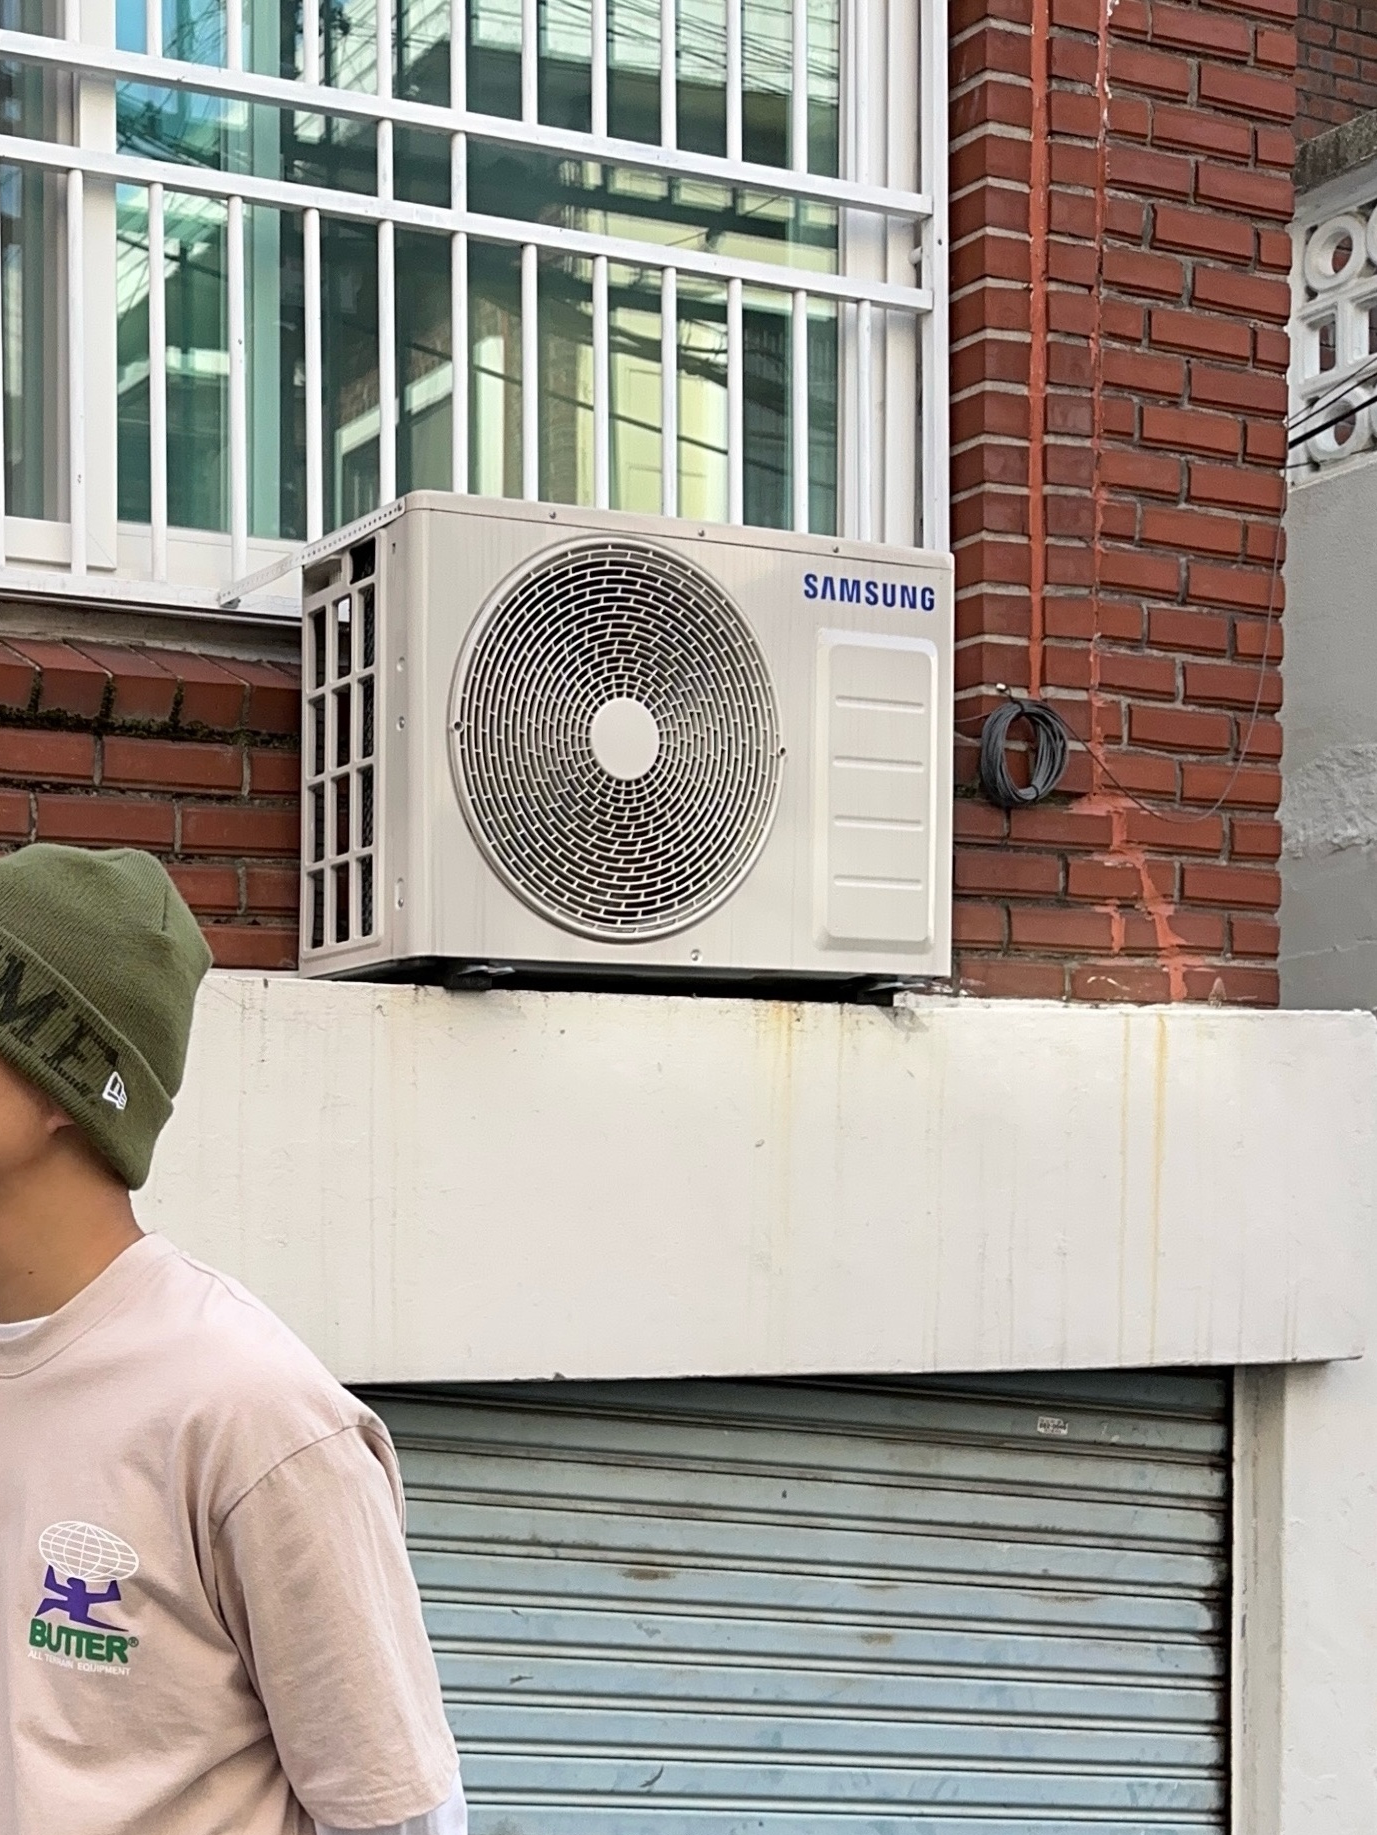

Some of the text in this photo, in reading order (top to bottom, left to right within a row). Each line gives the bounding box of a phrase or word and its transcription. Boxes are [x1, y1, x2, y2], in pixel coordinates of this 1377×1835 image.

[804, 573, 935, 611] SAMSUNG
[27, 1650, 43, 1661] ALL
[77, 1662, 131, 1676] EQUIPMENT
